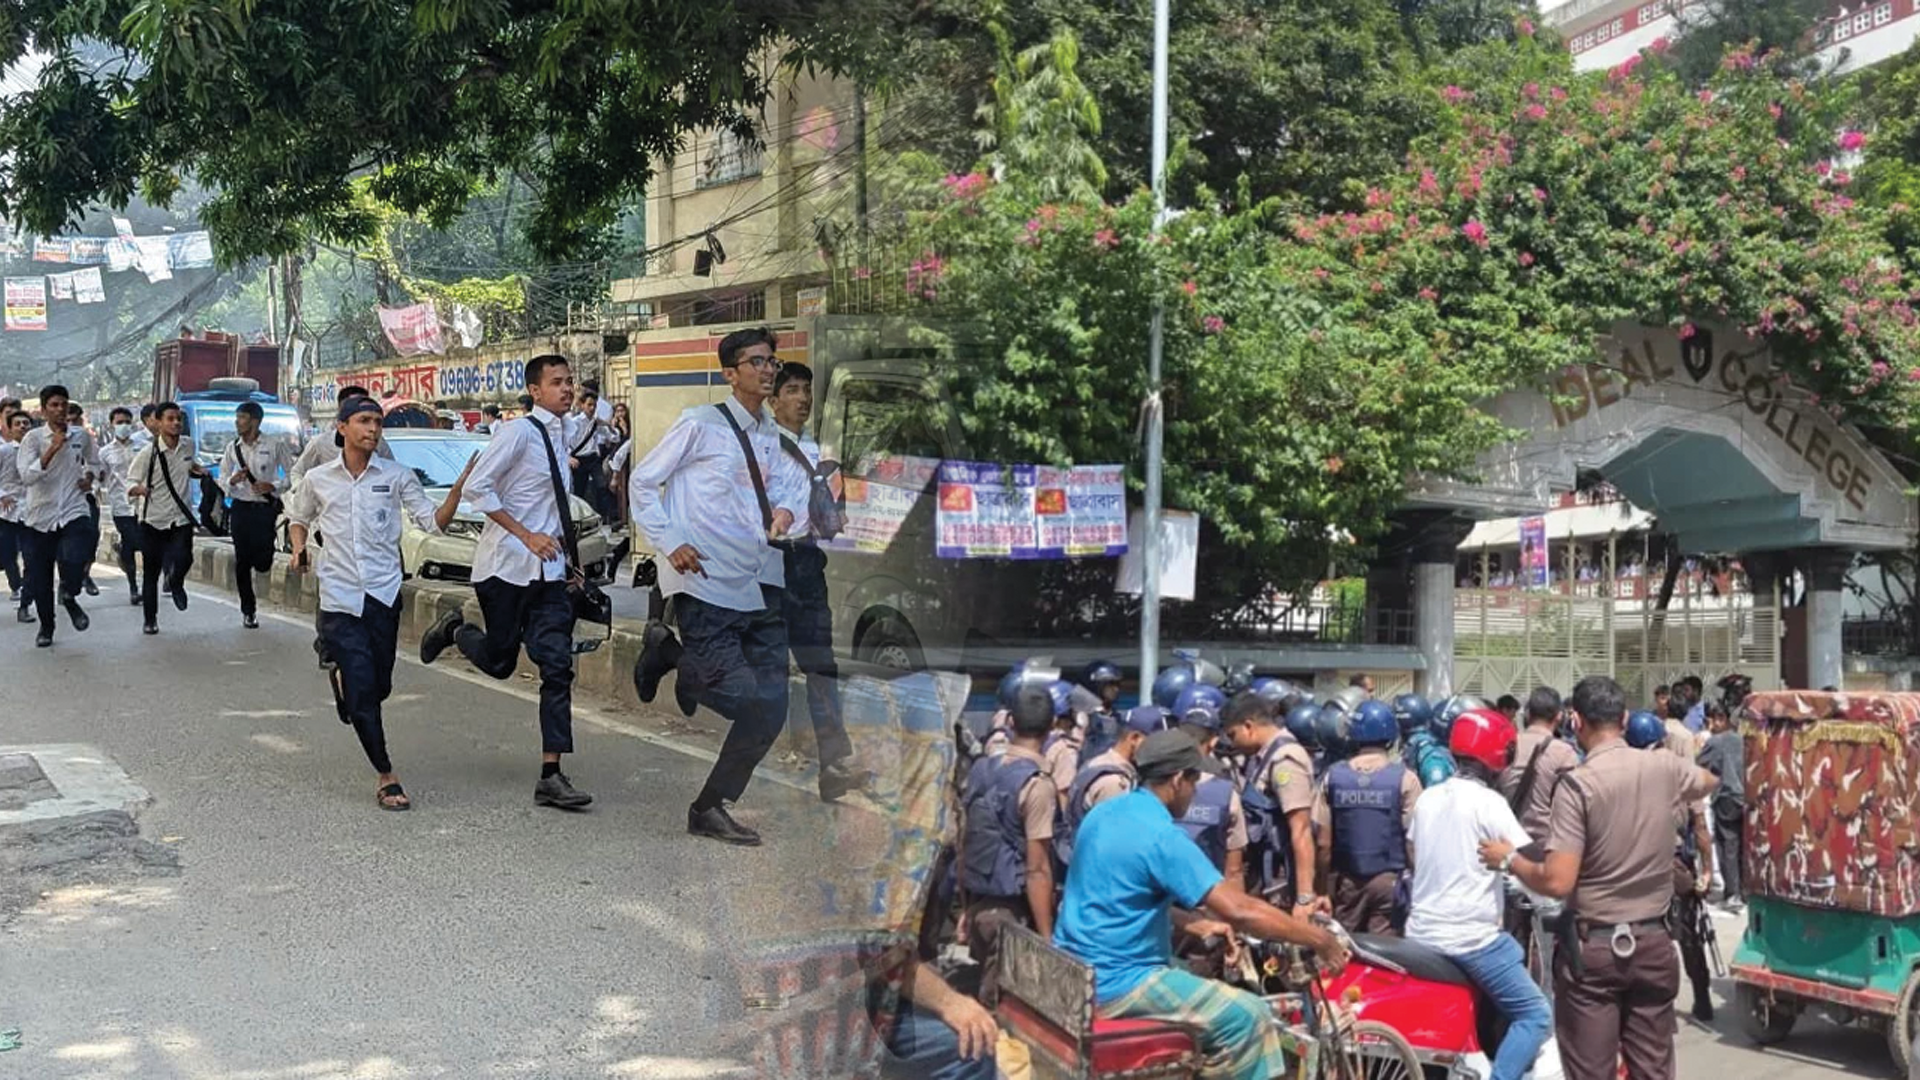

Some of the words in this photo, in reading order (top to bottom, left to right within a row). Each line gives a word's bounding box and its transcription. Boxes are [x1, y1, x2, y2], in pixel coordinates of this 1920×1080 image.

[1551, 338, 1674, 428] IDEAL
[1718, 349, 1872, 511] COLLEGE
[1340, 790, 1384, 804] POLICE
